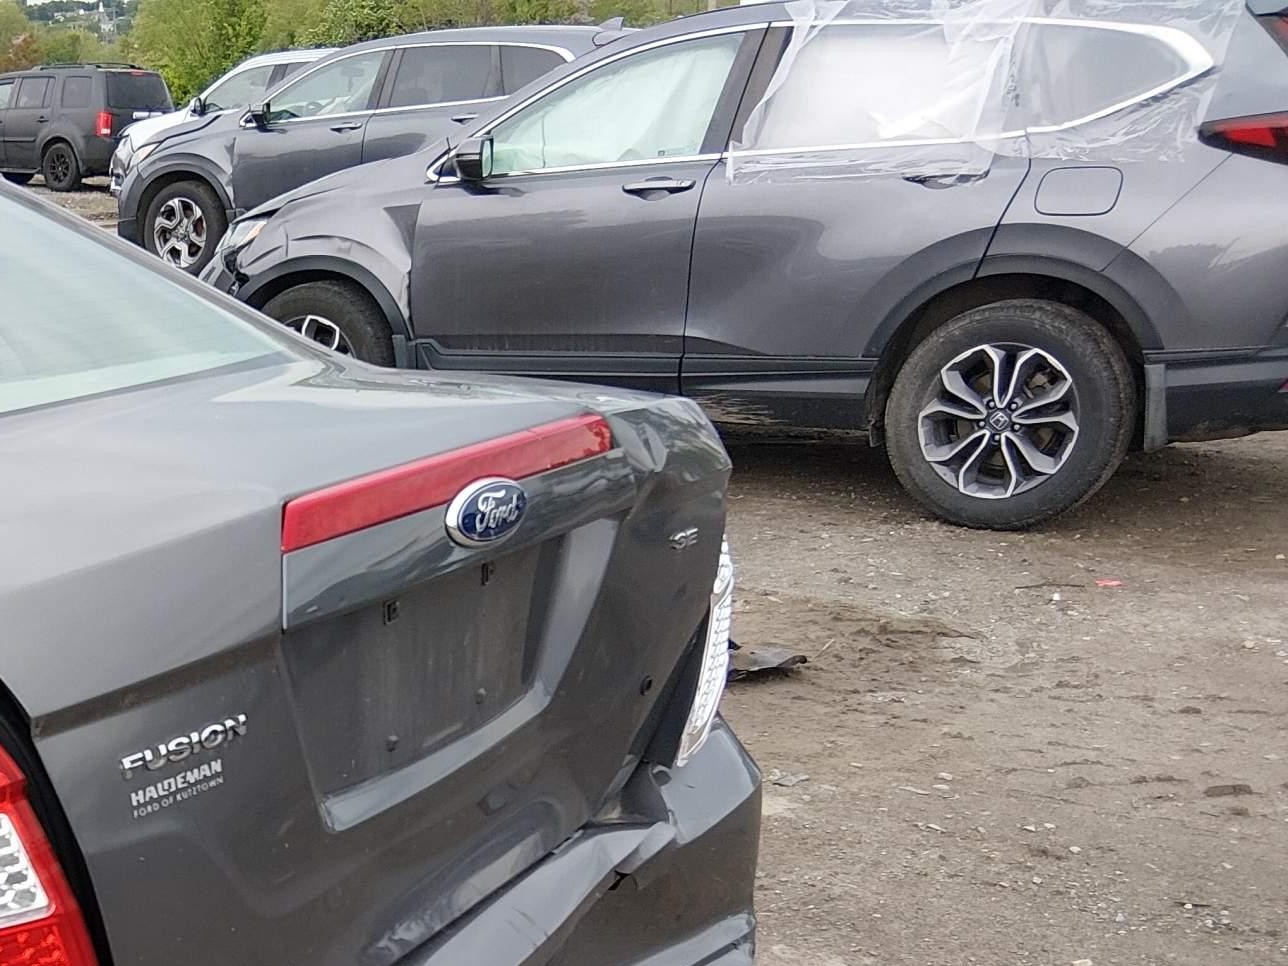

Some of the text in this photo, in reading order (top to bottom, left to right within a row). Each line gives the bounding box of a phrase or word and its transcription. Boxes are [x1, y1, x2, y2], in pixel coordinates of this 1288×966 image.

[475, 489, 519, 532] Ford
[670, 528, 699, 549] SE
[120, 713, 248, 779] FUSION
[130, 758, 223, 806] HALDEMAN
[133, 776, 224, 819] FORD OF KUTZTOWN
